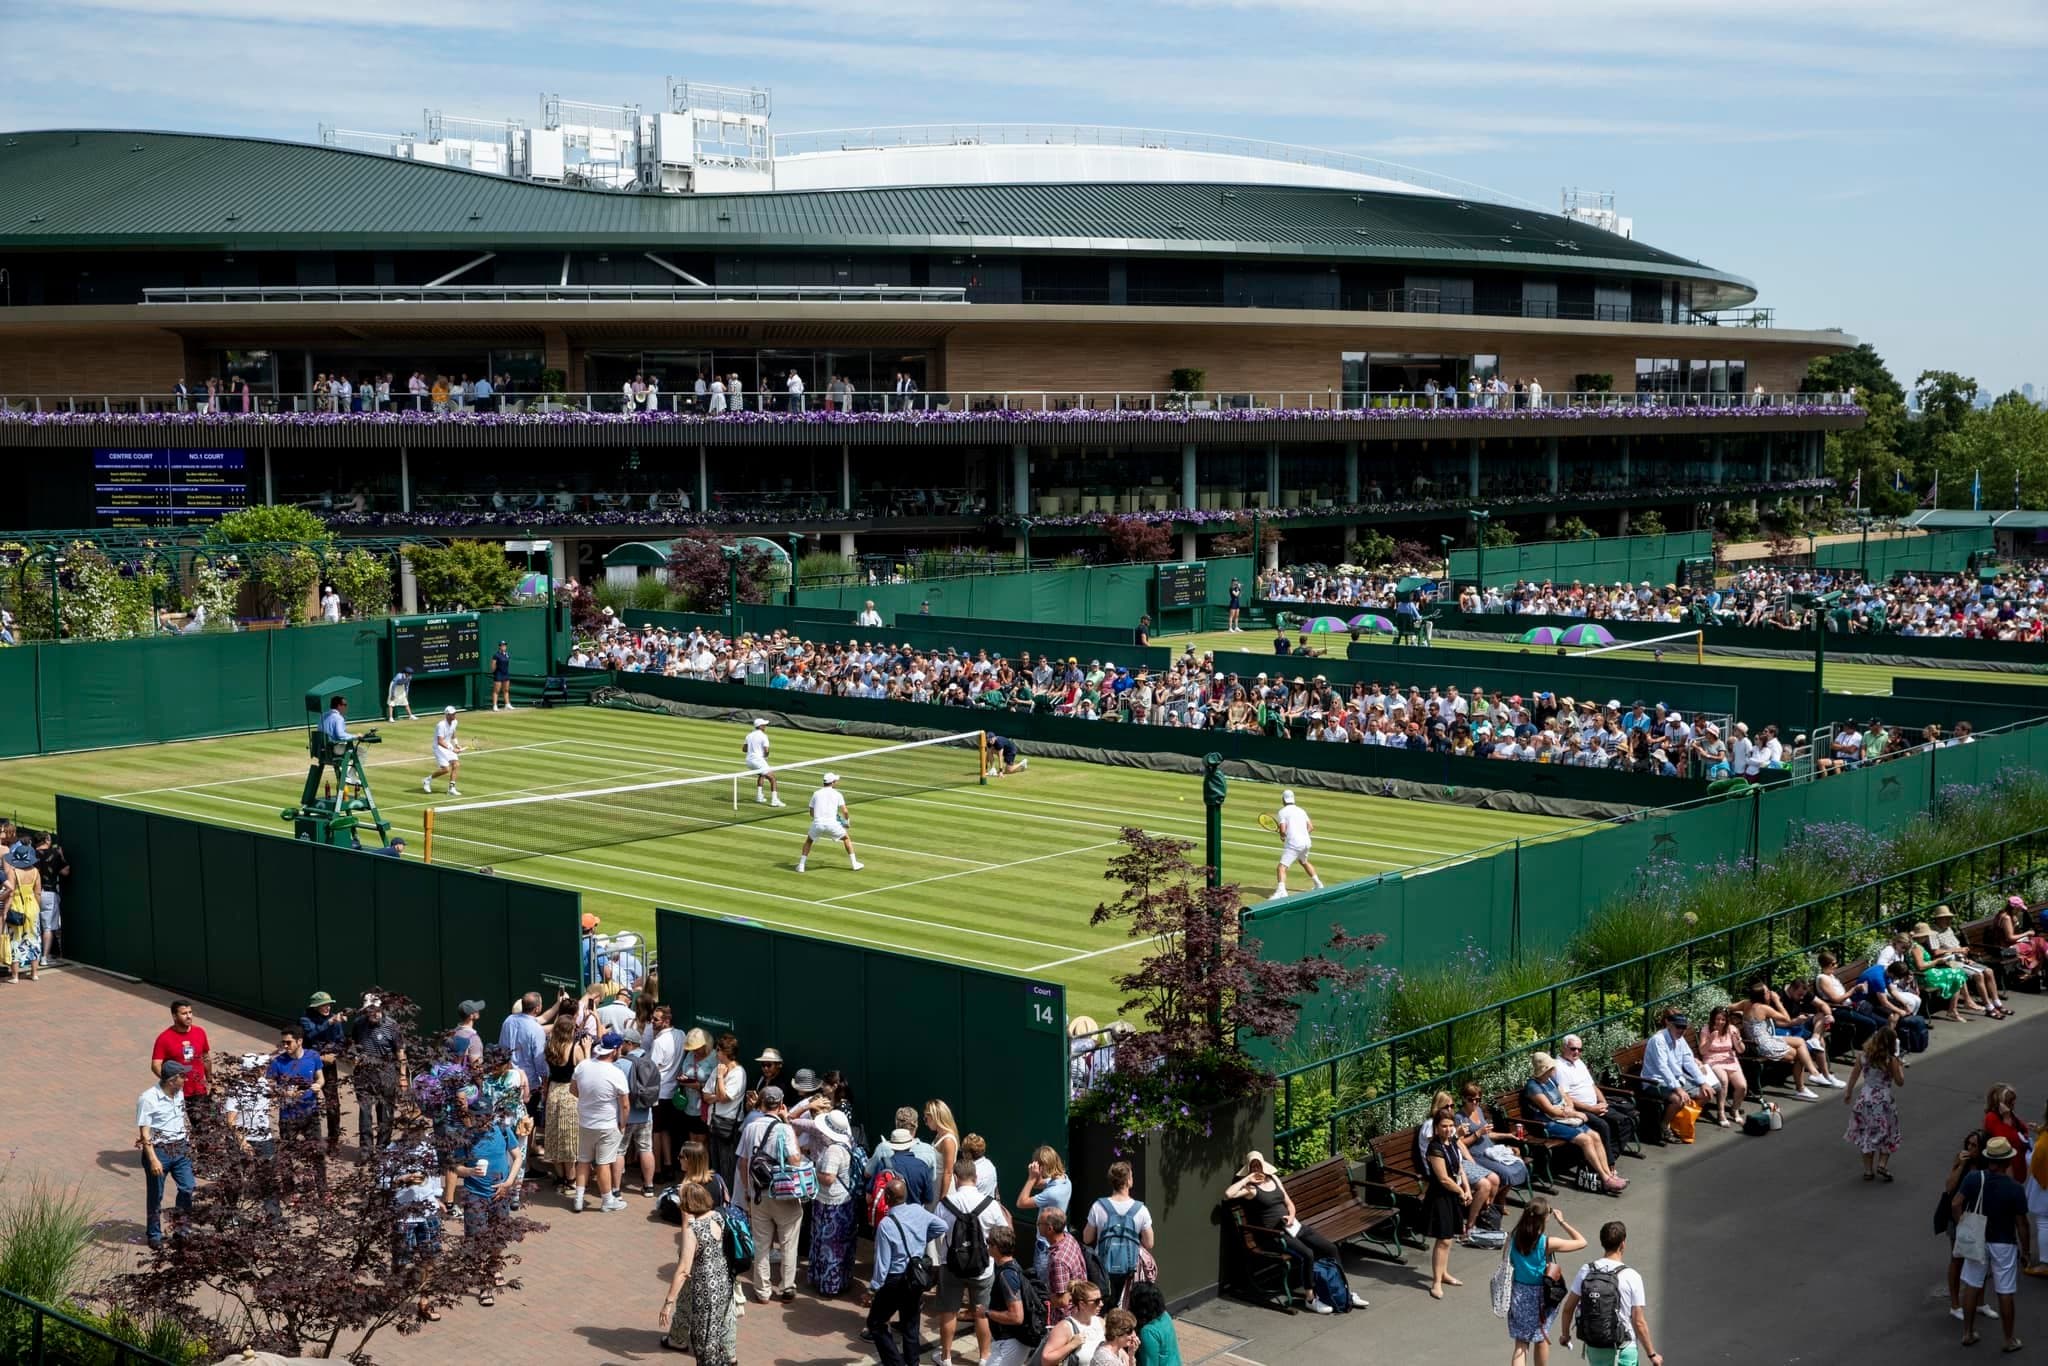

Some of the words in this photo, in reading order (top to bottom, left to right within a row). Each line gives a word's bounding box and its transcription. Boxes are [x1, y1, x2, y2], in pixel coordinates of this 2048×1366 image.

[579, 543, 593, 564] 2
[1033, 986, 1052, 997] Court
[1033, 1003, 1054, 1025] 14
